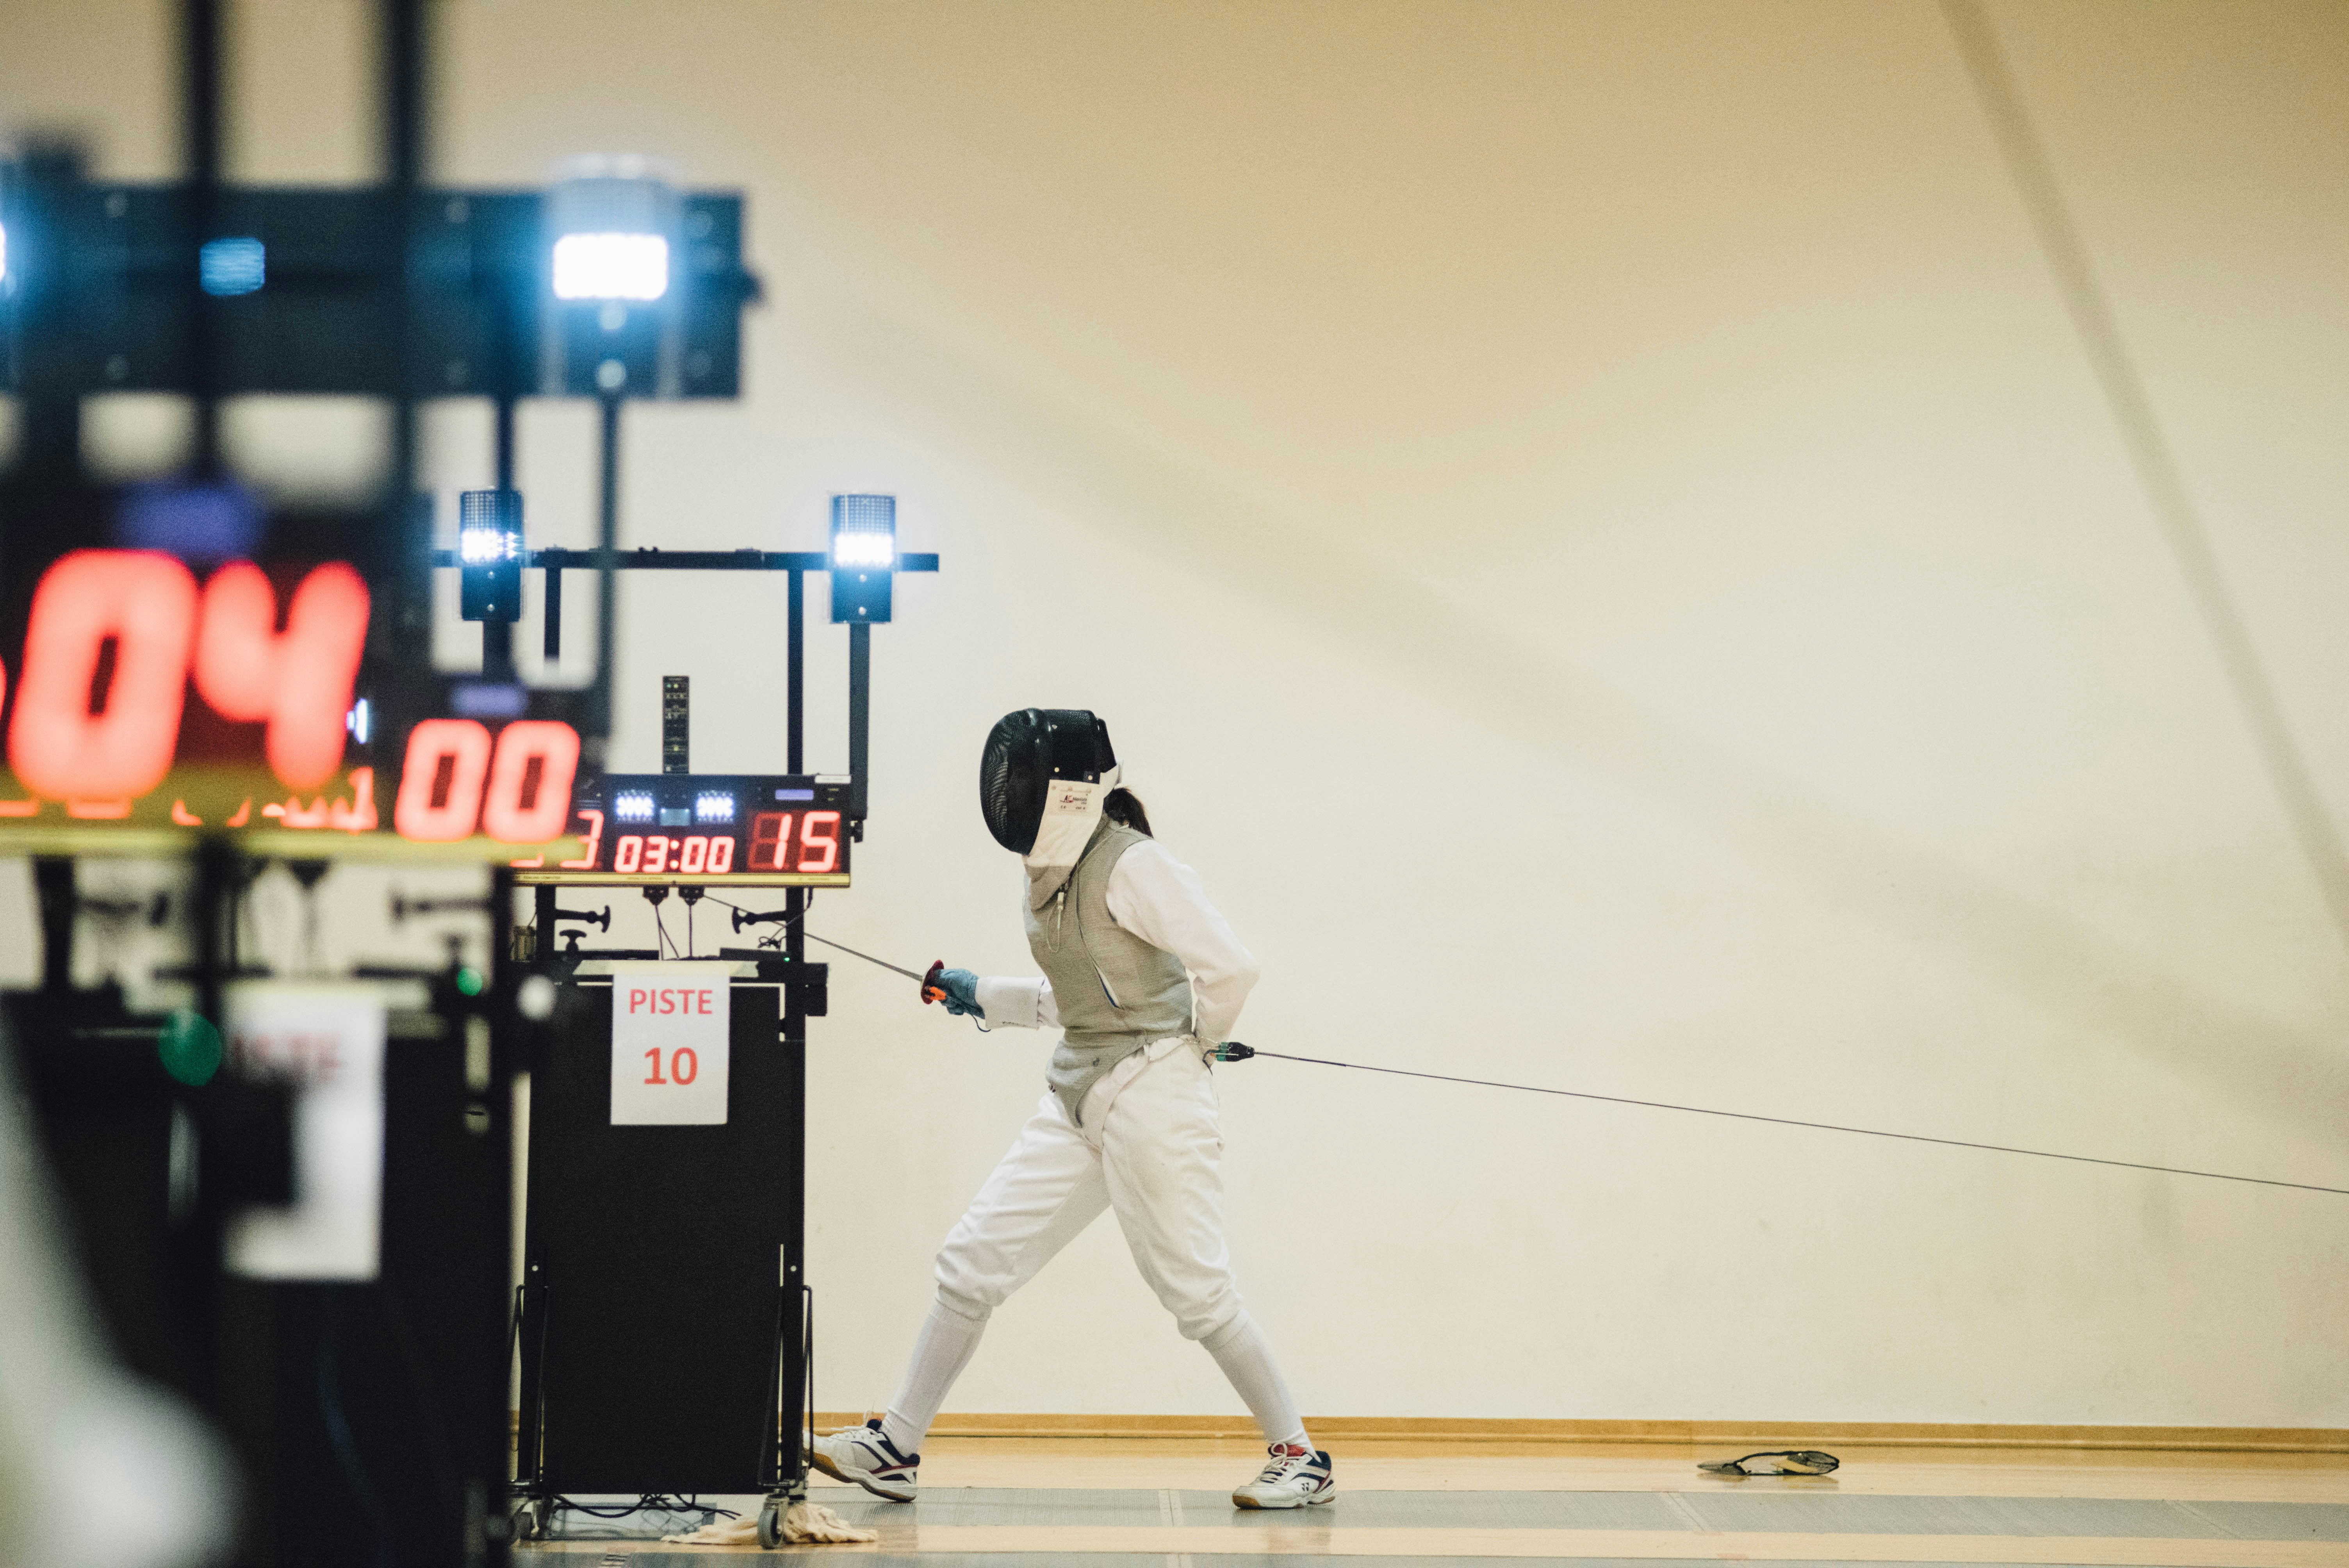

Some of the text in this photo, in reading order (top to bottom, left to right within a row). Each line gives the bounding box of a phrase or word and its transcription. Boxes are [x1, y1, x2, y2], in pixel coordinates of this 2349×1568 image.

[394, 719, 580, 843] 00
[615, 836, 734, 873] 03:00
[772, 811, 840, 873] 15
[629, 989, 713, 1014] PISTE
[644, 1047, 698, 1085] 10
